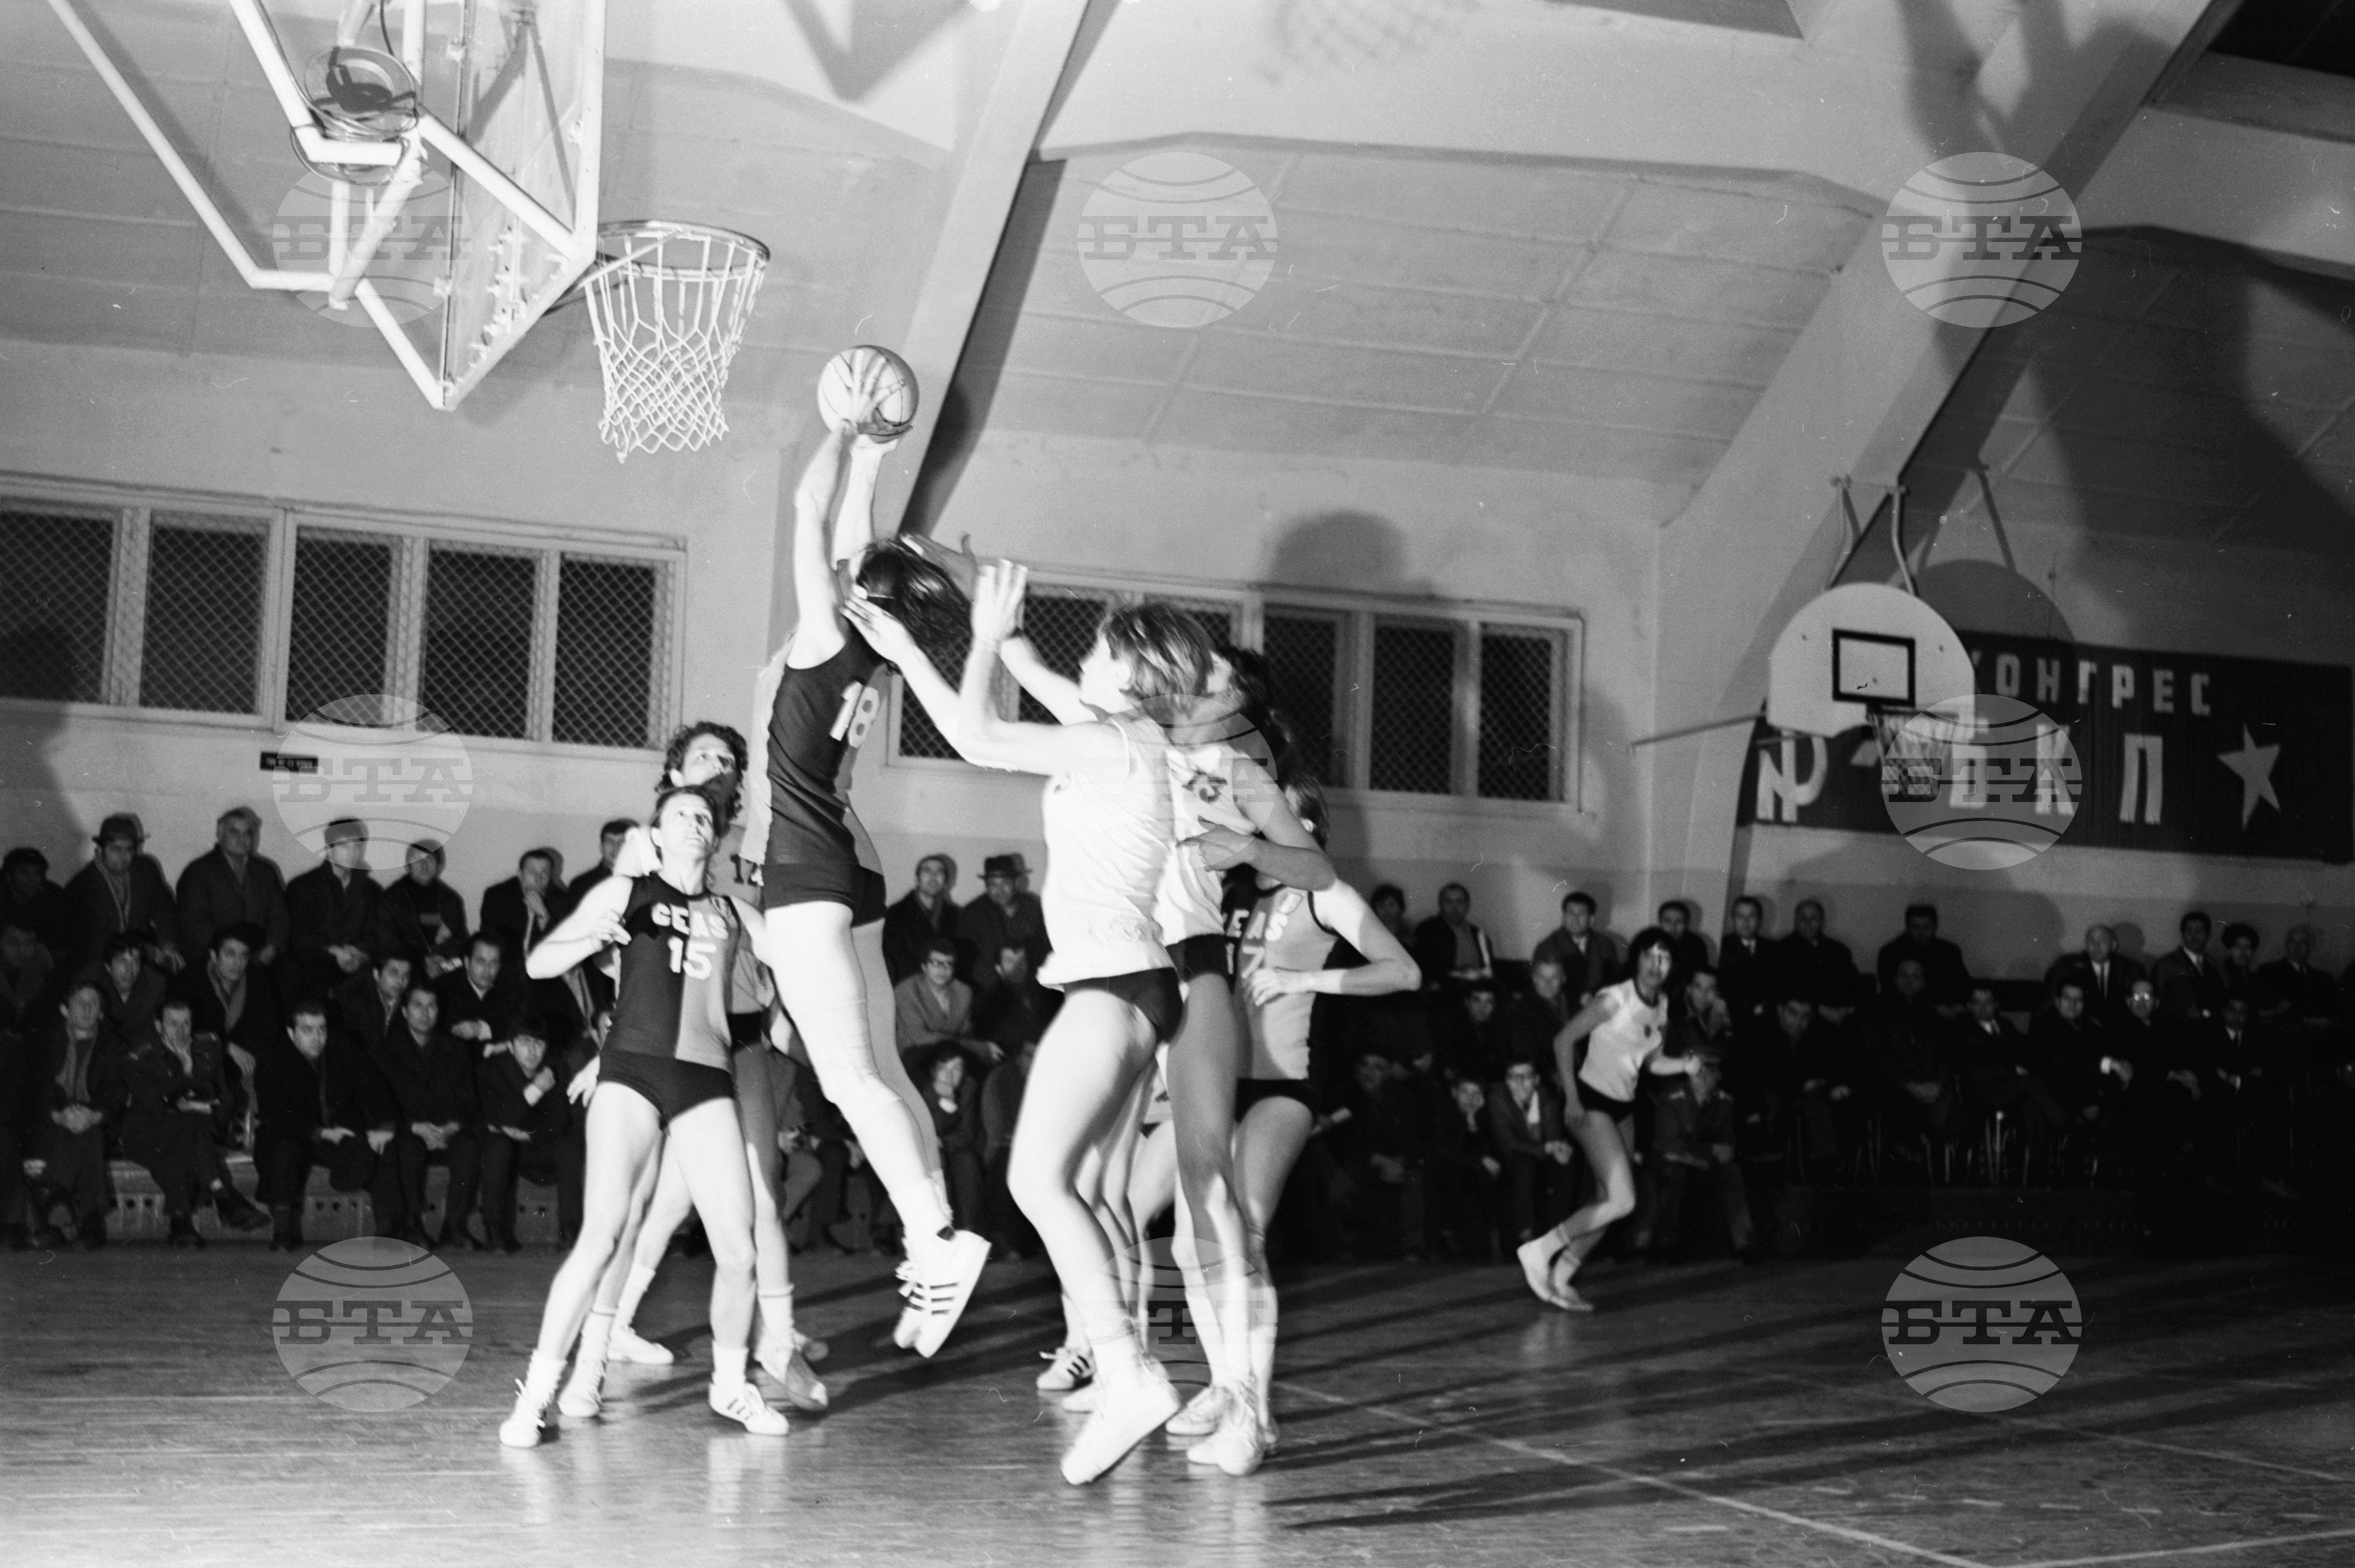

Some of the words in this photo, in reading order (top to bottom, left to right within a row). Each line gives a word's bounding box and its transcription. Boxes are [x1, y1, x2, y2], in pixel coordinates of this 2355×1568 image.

[829, 680, 880, 750] 18
[1222, 909, 1288, 942] EAS
[668, 935, 717, 980] 15
